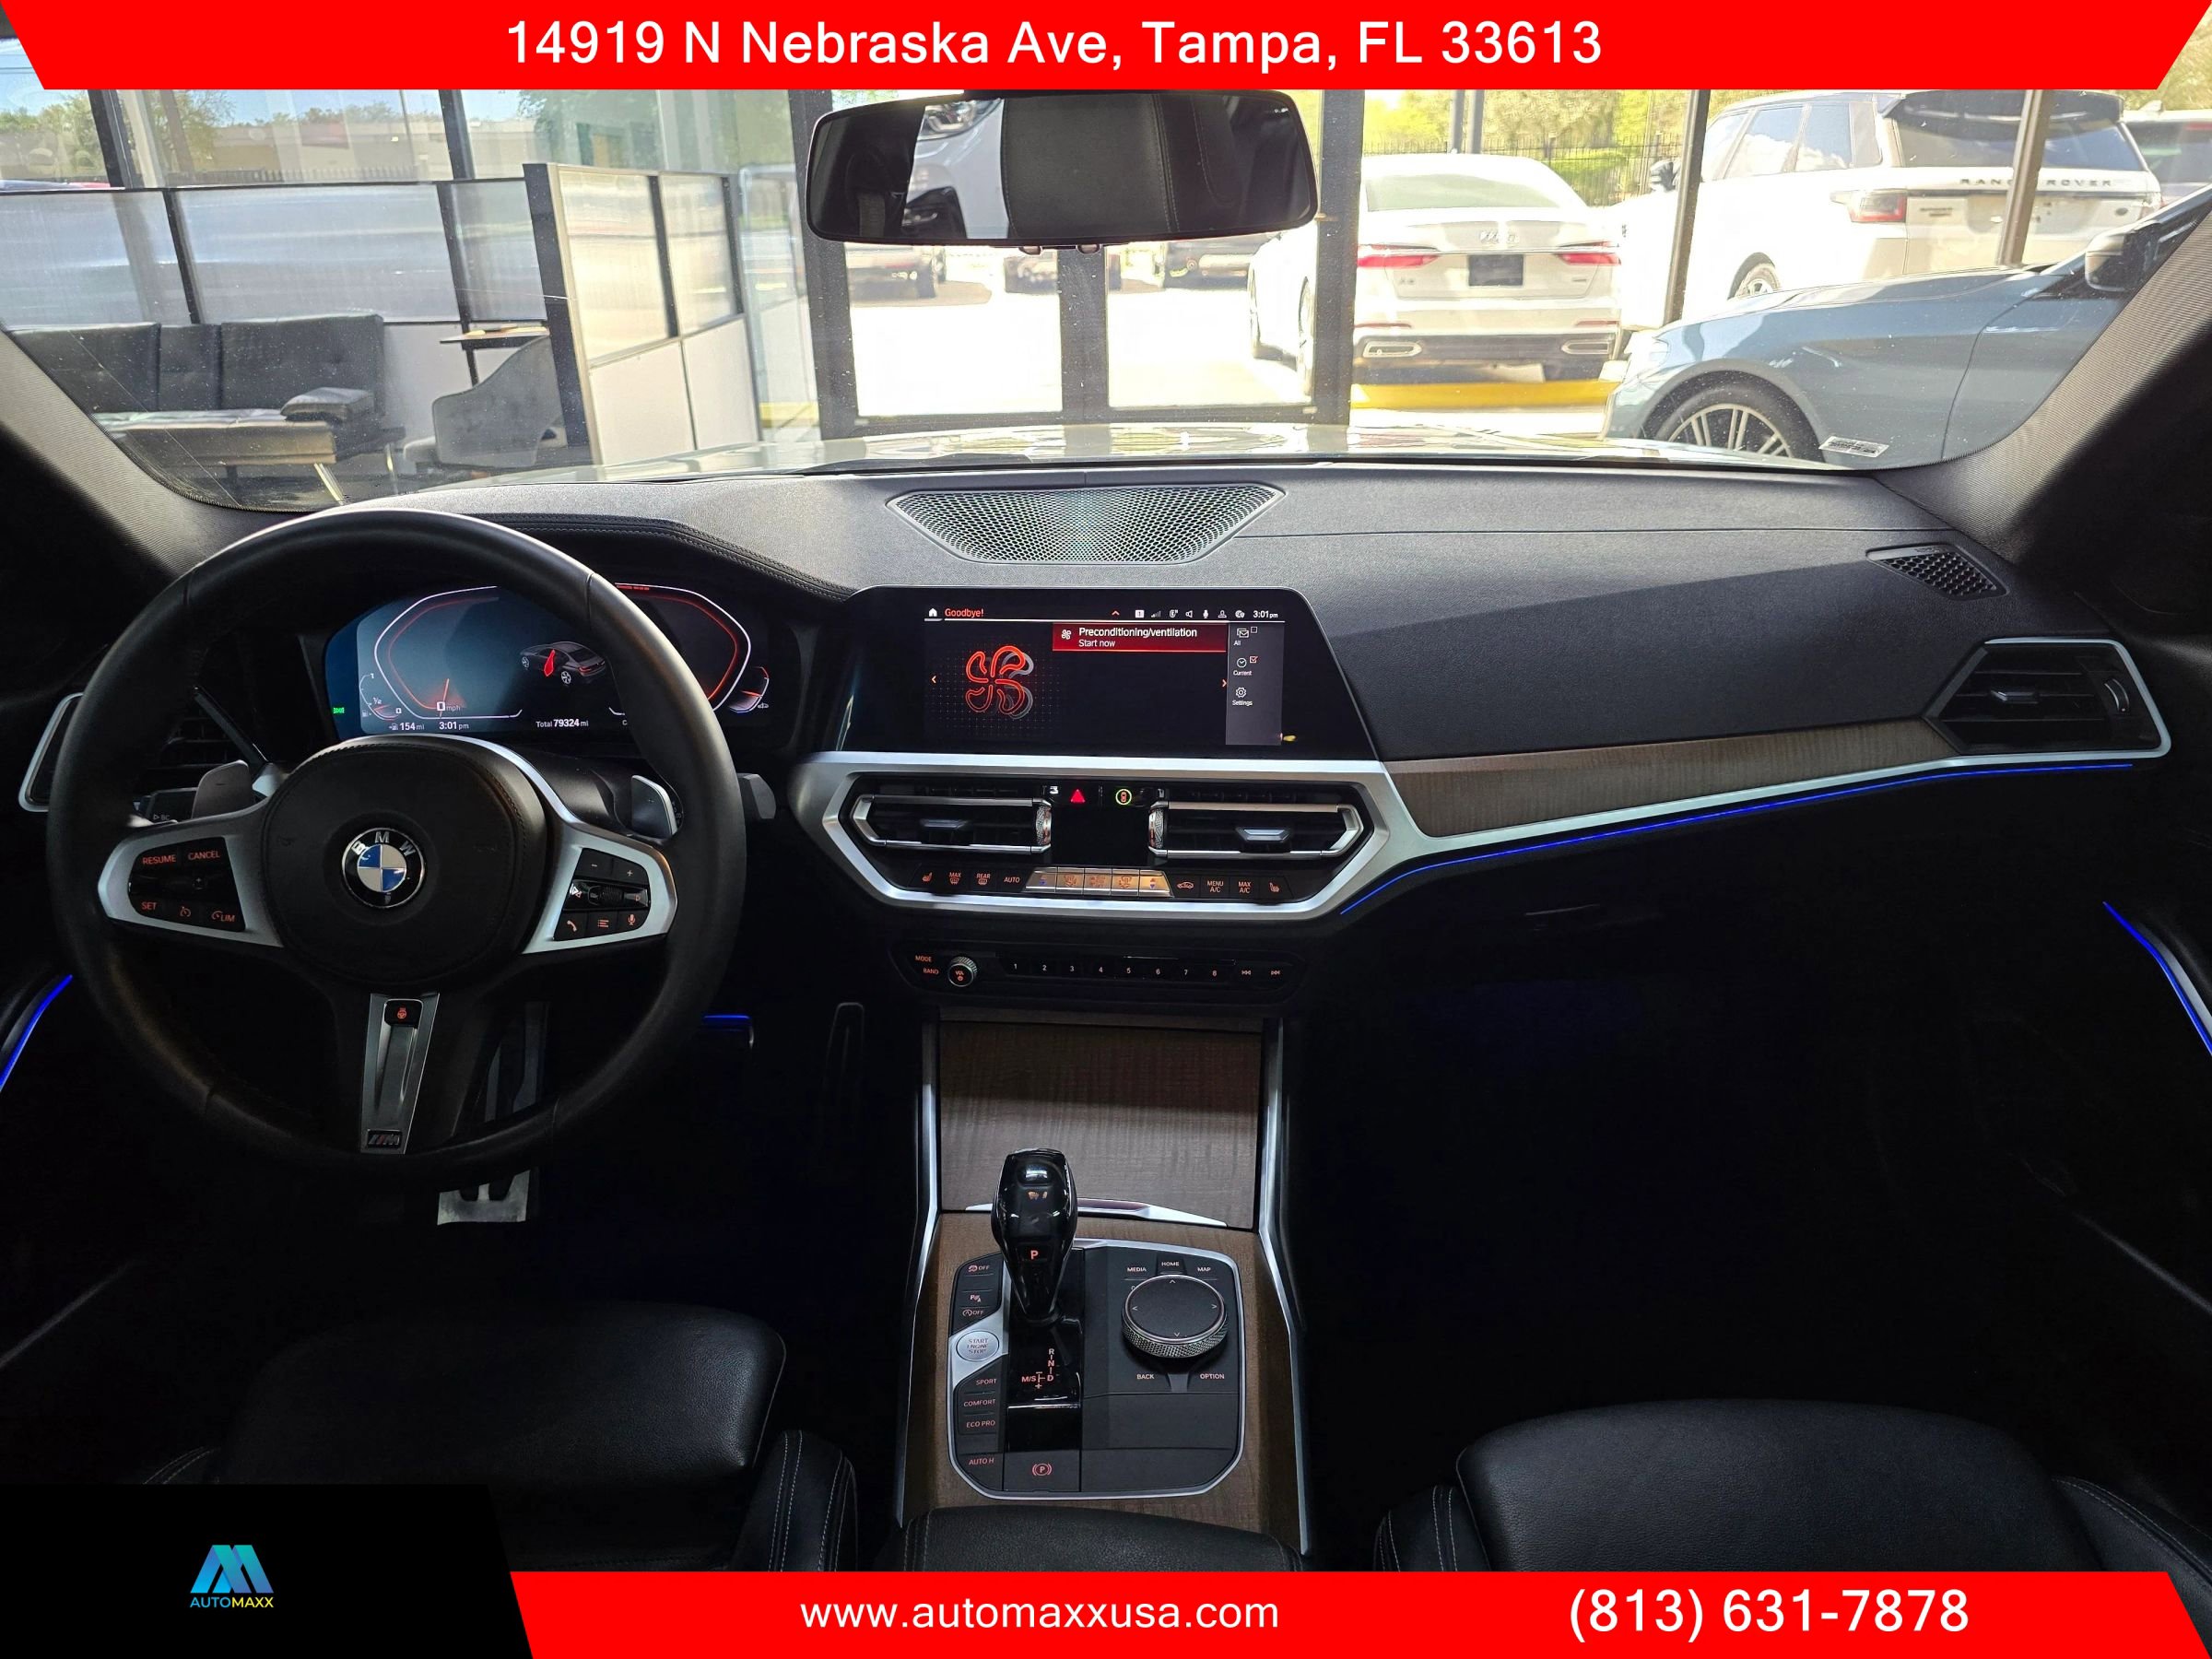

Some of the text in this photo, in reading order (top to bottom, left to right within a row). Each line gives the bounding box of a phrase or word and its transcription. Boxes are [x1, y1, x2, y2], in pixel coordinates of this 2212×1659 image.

[2045, 179, 2112, 187] ROVER
[944, 608, 984, 618] Goodbye!
[1078, 627, 1197, 639] Preconditioning/ventilation
[1078, 639, 1098, 648] Start
[1231, 699, 1253, 707] Settings
[399, 722, 416, 731] 154
[439, 721, 457, 731] 3:01
[553, 719, 580, 727] 79324
[351, 830, 417, 856] BMW
[142, 853, 178, 865] RESUME
[188, 850, 221, 861] CANCEL
[141, 901, 157, 911] SET
[915, 955, 933, 963] MODE
[1030, 1250, 1039, 1260] P
[975, 1378, 997, 1386] SPORT
[963, 1398, 996, 1407] COMFORT
[966, 1420, 981, 1429] ECO
